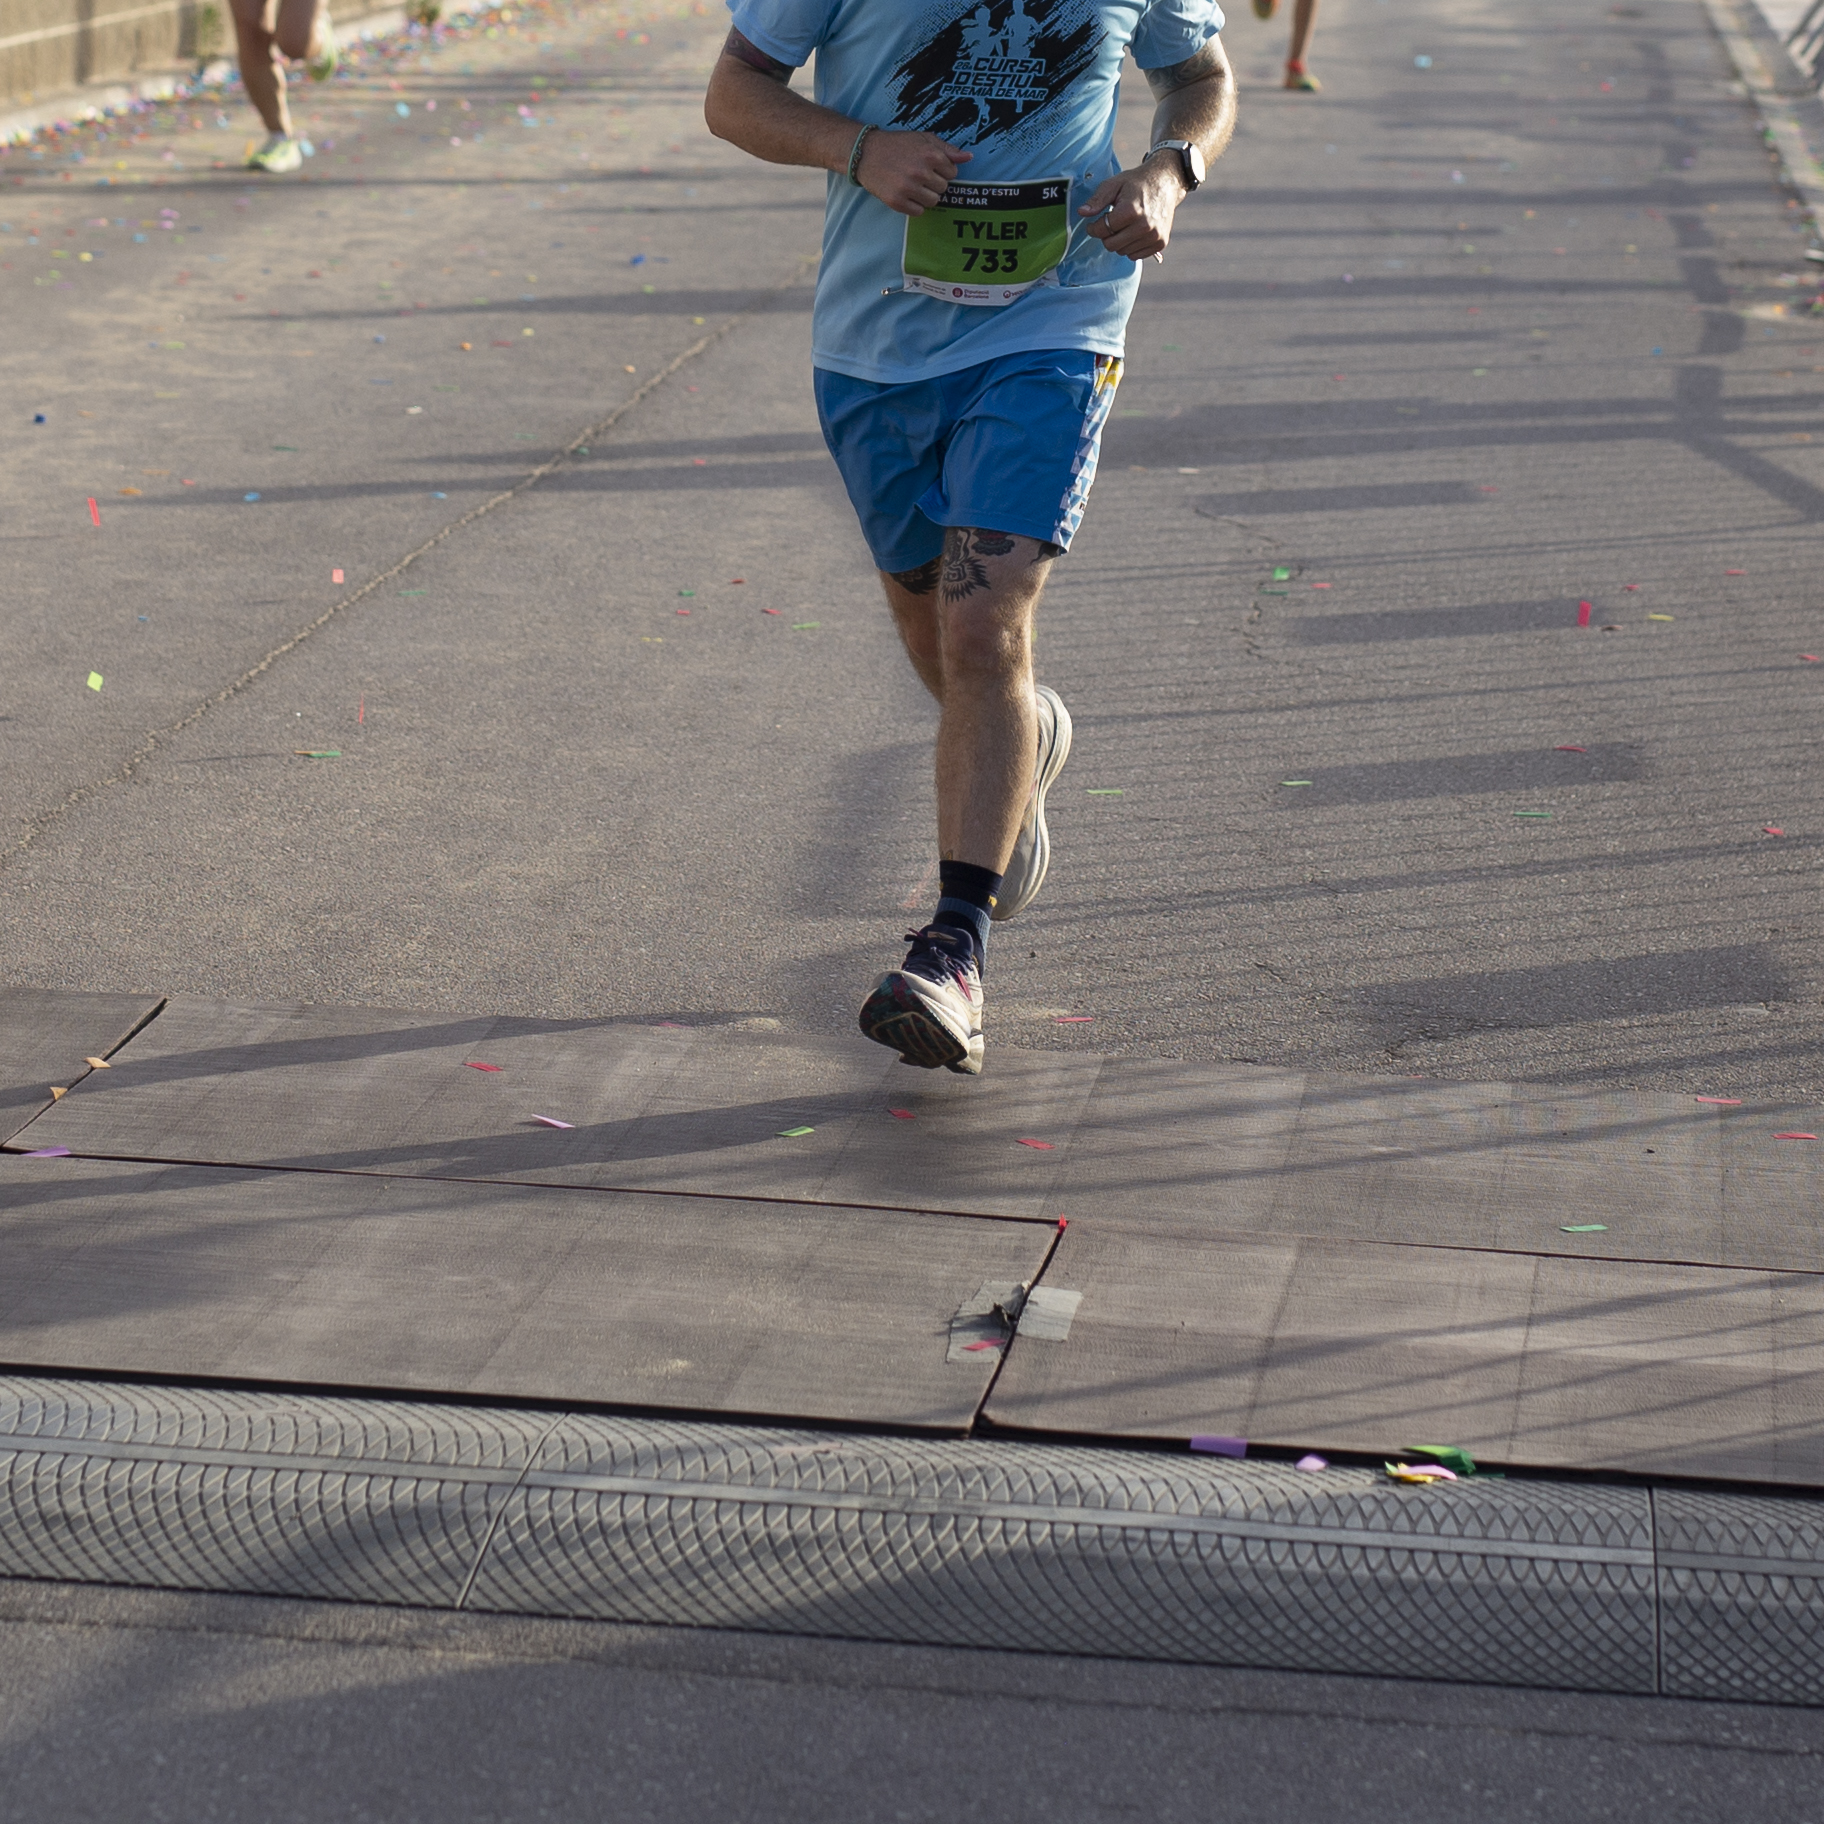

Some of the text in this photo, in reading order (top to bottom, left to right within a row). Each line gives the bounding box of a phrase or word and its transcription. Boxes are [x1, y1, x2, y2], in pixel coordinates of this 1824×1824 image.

[973, 57, 1044, 74] CURSA
[954, 71, 1033, 88] D'ESTIU
[995, 87, 1015, 97] DE
[1015, 89, 1047, 99] MAR
[947, 186, 1020, 196] CURSA D'ESTIU
[1042, 186, 1059, 199] 5K
[951, 196, 964, 204] DE
[966, 197, 988, 206] MAR
[953, 219, 1028, 241] TYLER
[962, 247, 1018, 274] 733
